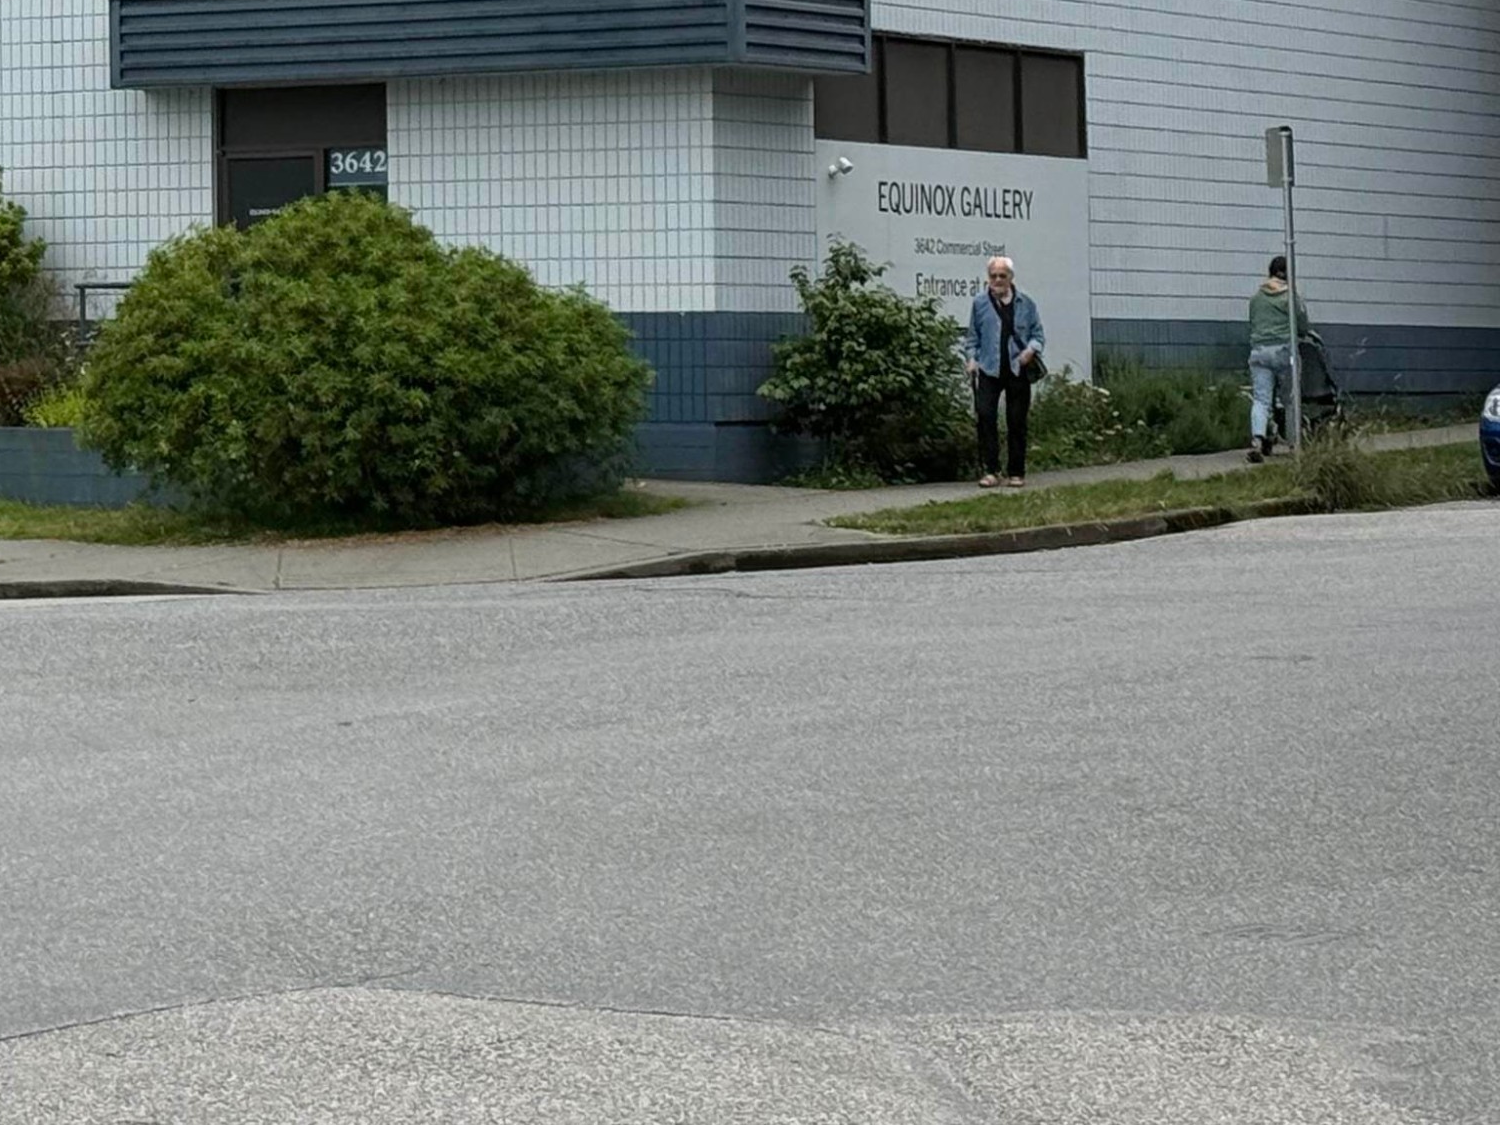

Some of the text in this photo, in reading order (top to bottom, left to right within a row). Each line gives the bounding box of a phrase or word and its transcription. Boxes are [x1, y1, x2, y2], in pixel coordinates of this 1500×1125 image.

[330, 150, 387, 174] 3642
[878, 181, 1034, 220] EQUINOX GALLERY
[914, 237, 1005, 256] 3642 Commercial Street
[916, 272, 967, 297] Entrance
[969, 276, 981, 297] at
